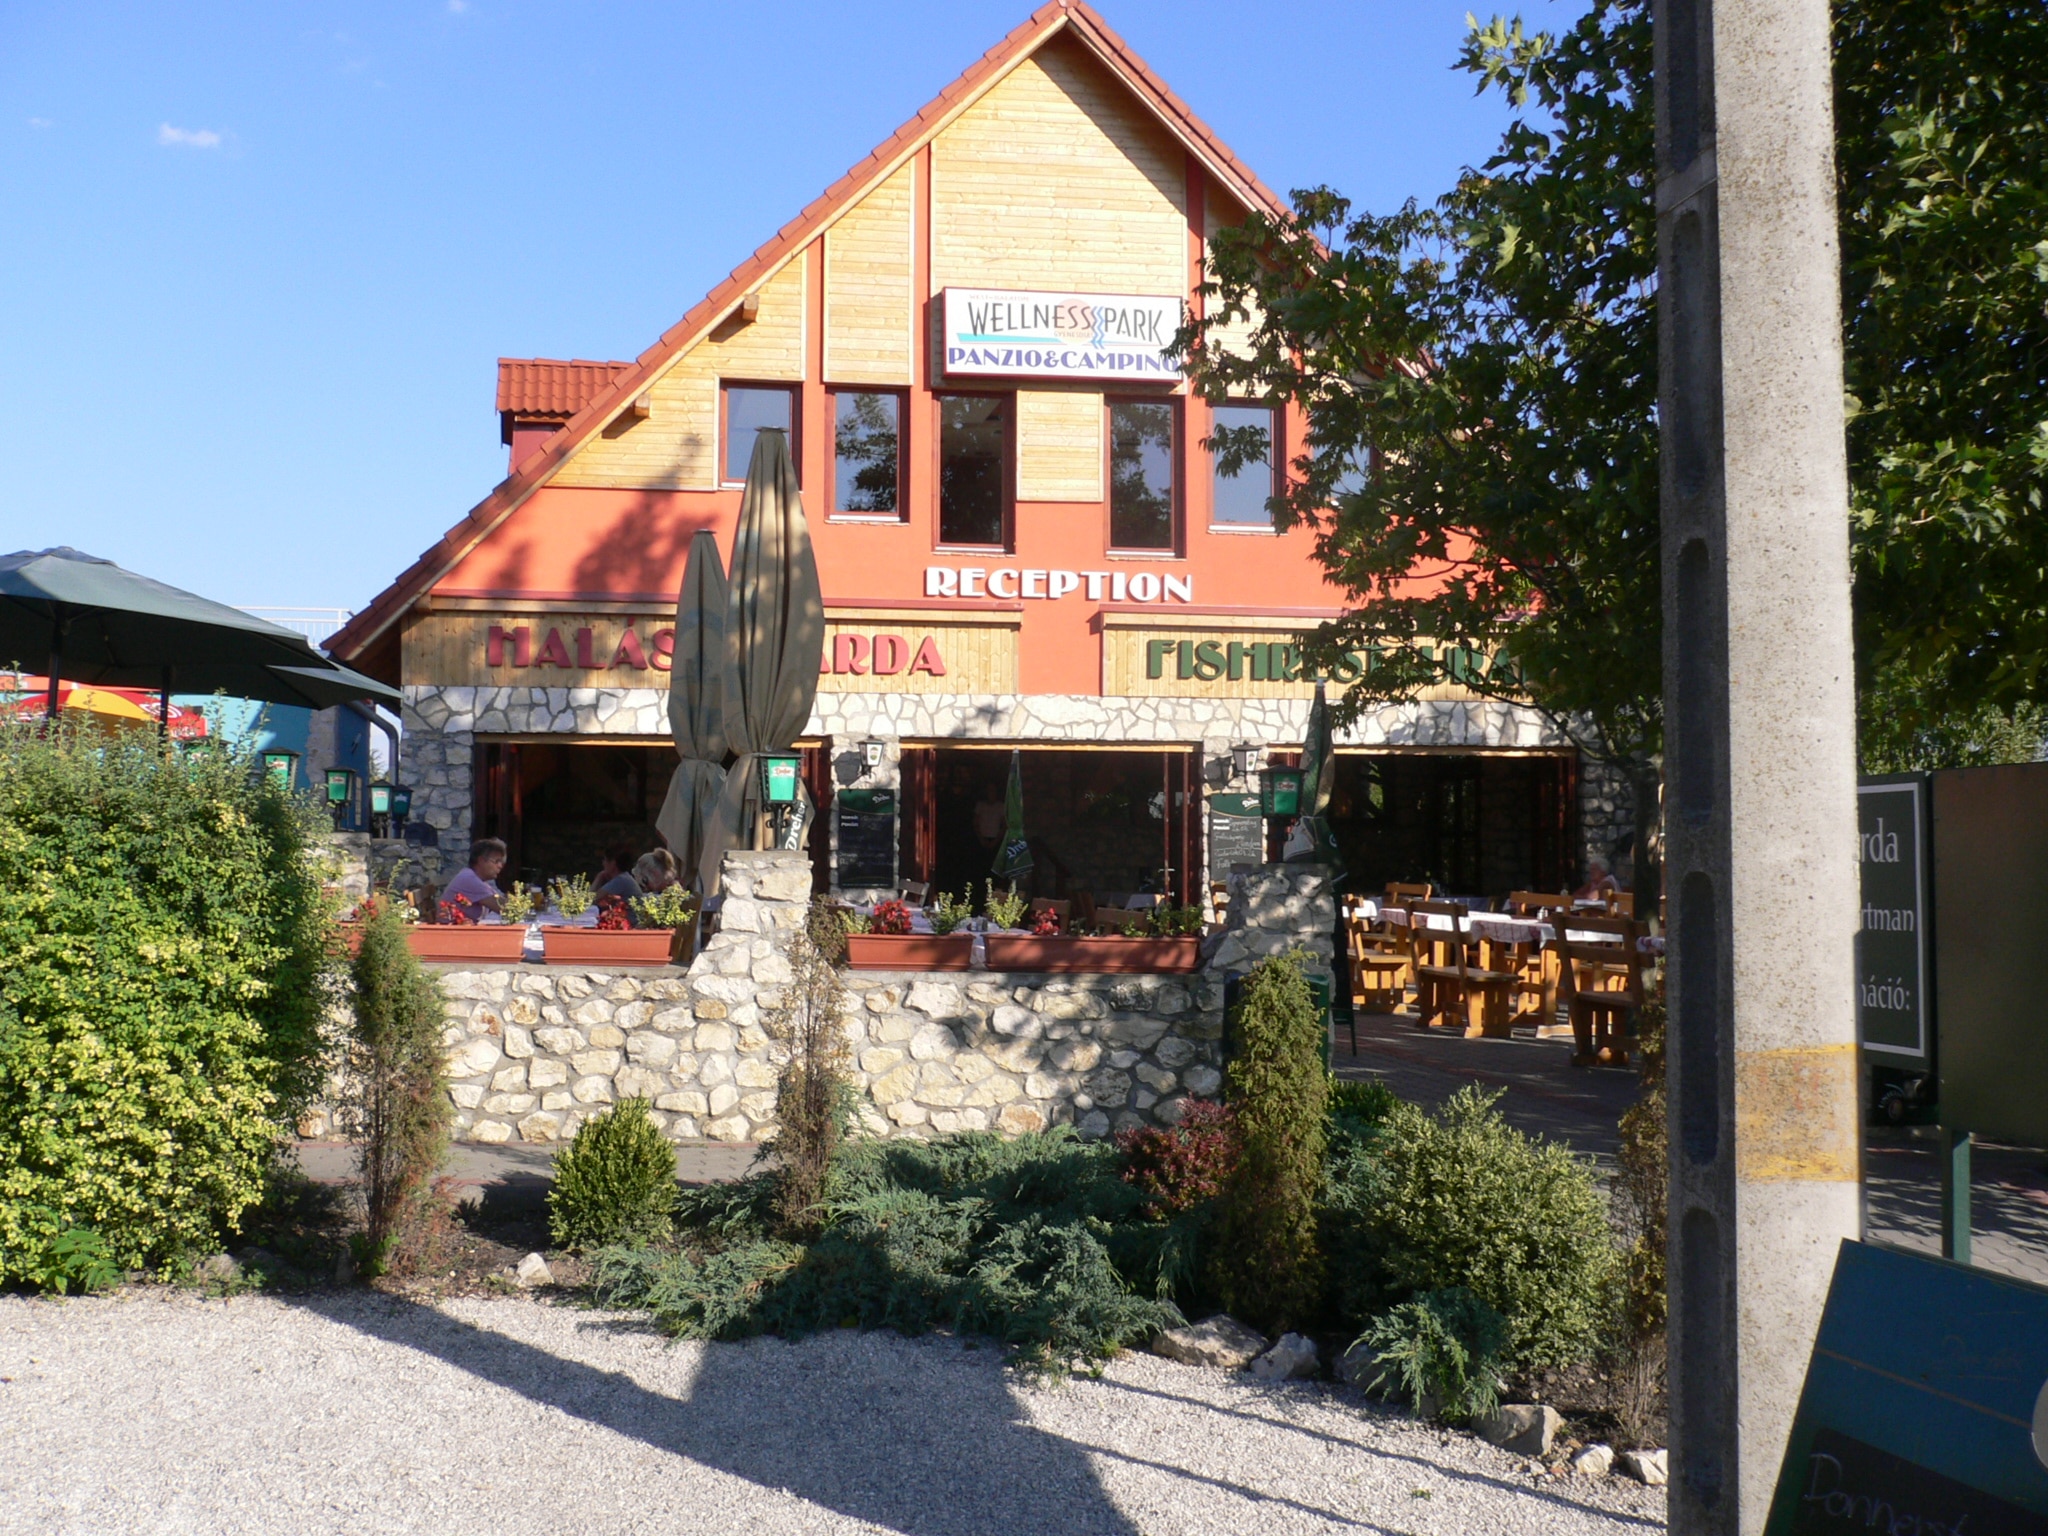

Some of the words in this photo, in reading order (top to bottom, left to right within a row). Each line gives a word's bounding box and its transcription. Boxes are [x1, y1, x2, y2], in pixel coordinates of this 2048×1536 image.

[967, 302, 1092, 336] WELLNESS
[1104, 306, 1163, 346] PARK
[924, 566, 1192, 602] RECEPTION
[785, 801, 807, 851] Dreher
[1859, 817, 1900, 864] rda
[1860, 901, 1915, 933] rtman
